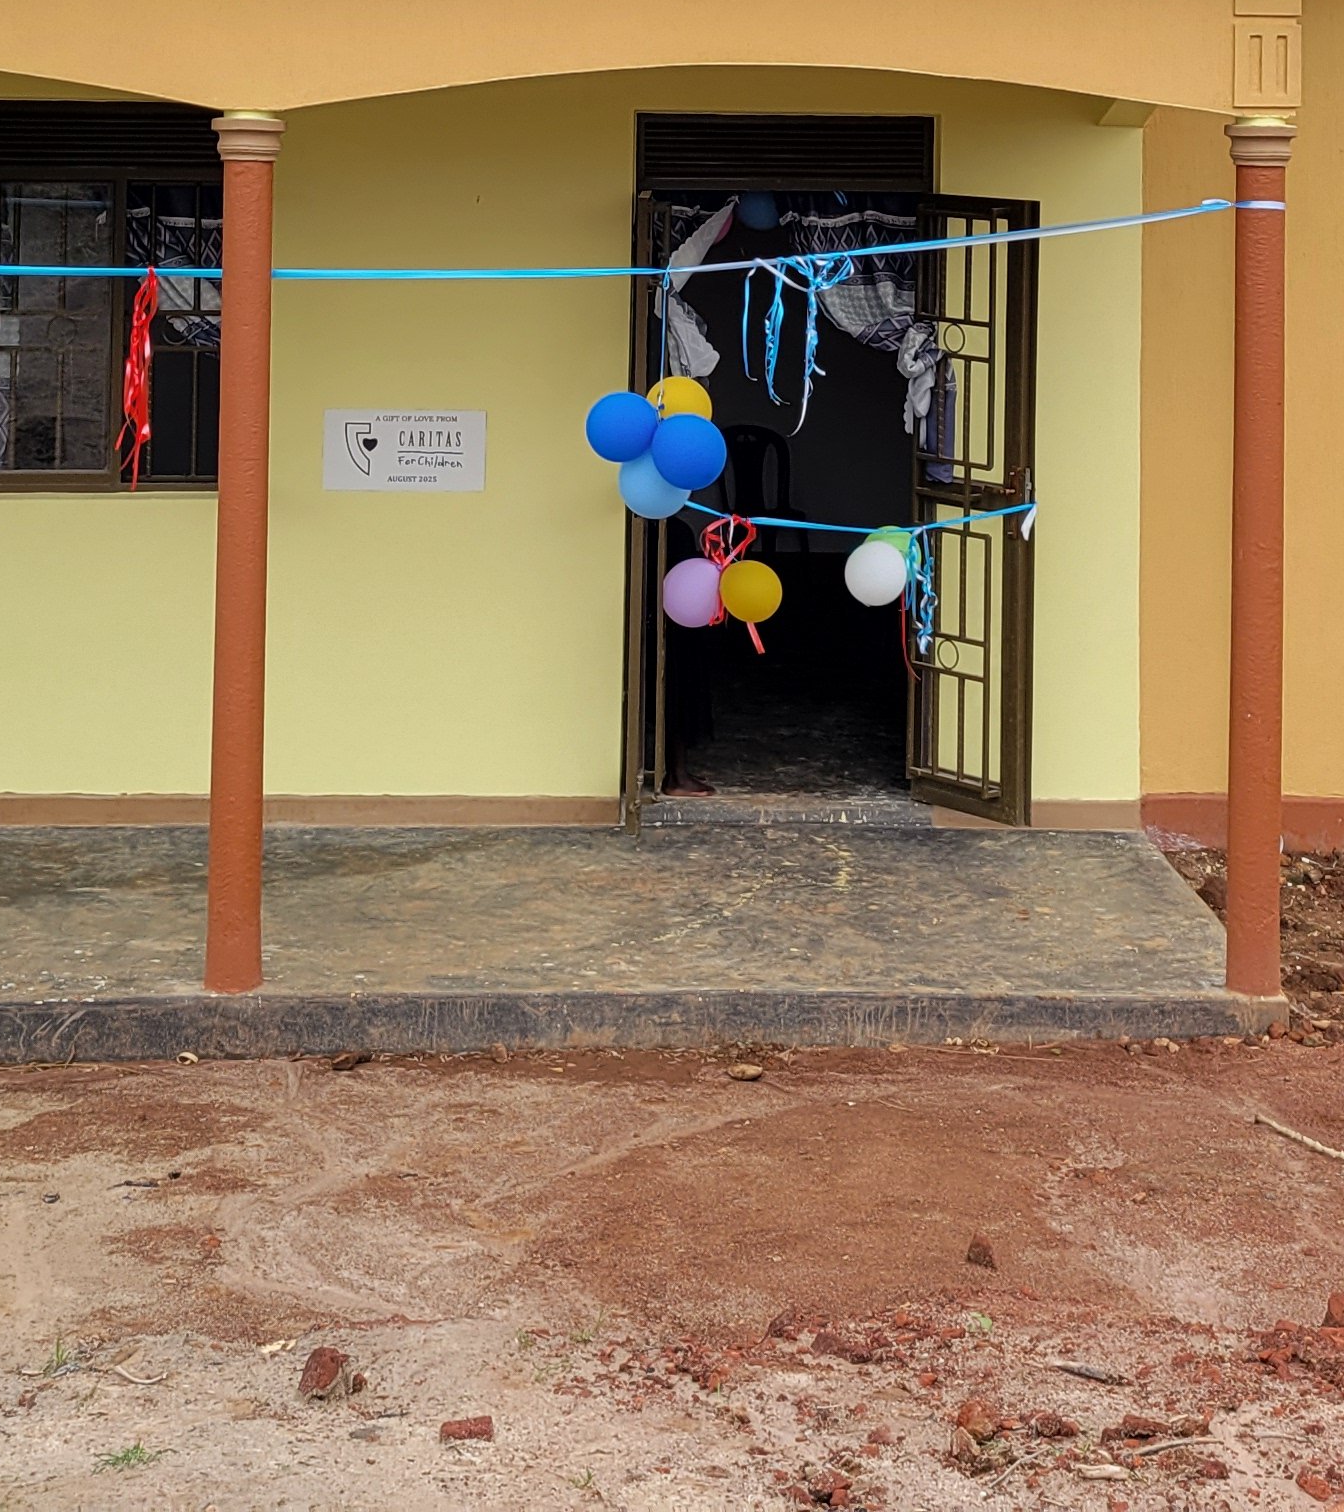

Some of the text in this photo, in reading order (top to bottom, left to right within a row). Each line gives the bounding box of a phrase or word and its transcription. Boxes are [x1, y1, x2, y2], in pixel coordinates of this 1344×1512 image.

[399, 430, 462, 447] CARITAS
[398, 455, 463, 468] For Children
[387, 475, 437, 483] AUGUST 2025
